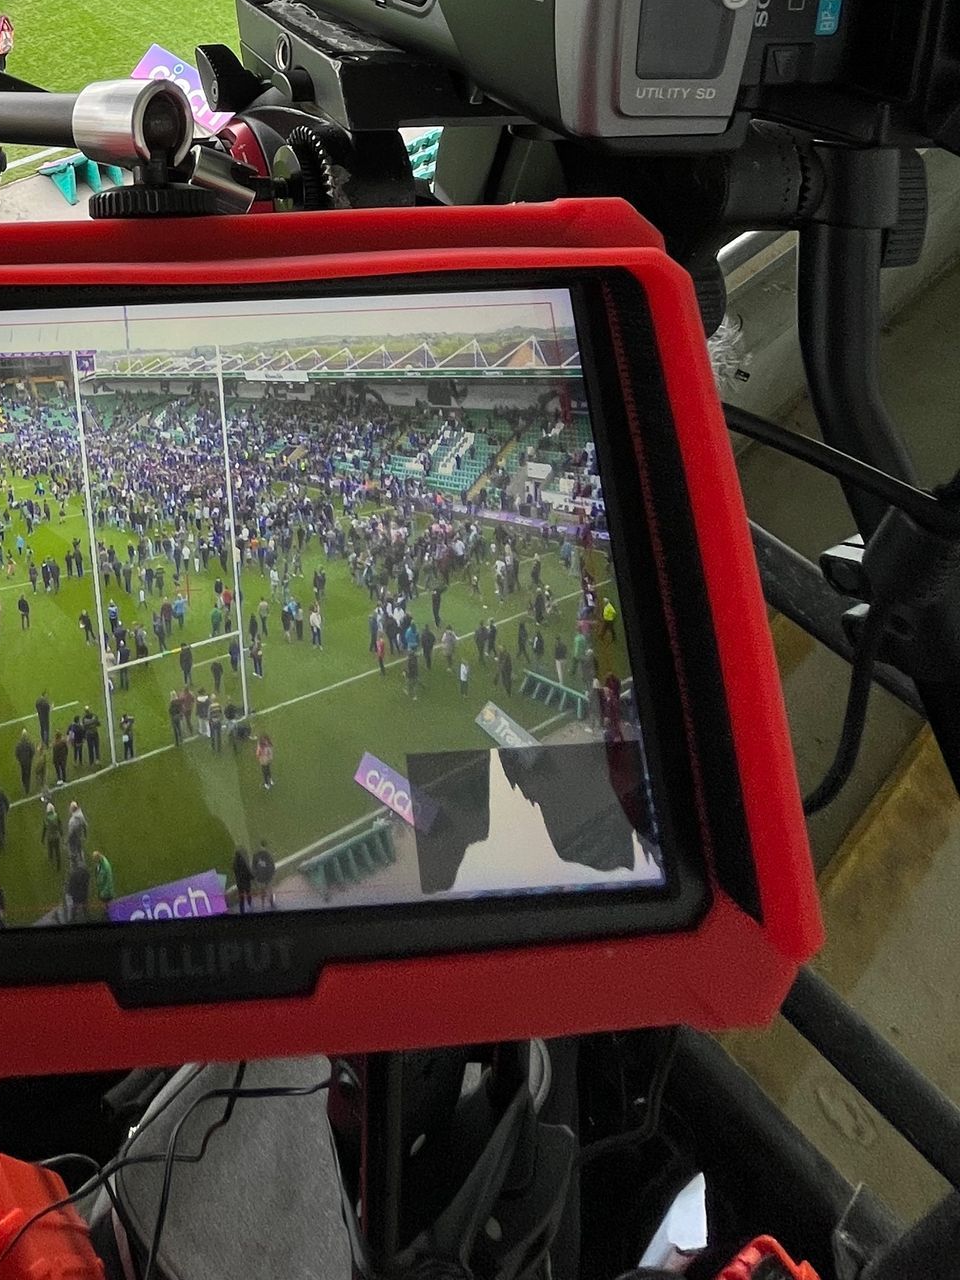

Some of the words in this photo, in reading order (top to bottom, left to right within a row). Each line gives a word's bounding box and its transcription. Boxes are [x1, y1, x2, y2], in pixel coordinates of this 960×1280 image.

[636, 87, 691, 99] UTILITY
[696, 87, 716, 99] SD
[120, 936, 293, 981] LILLIPUT
